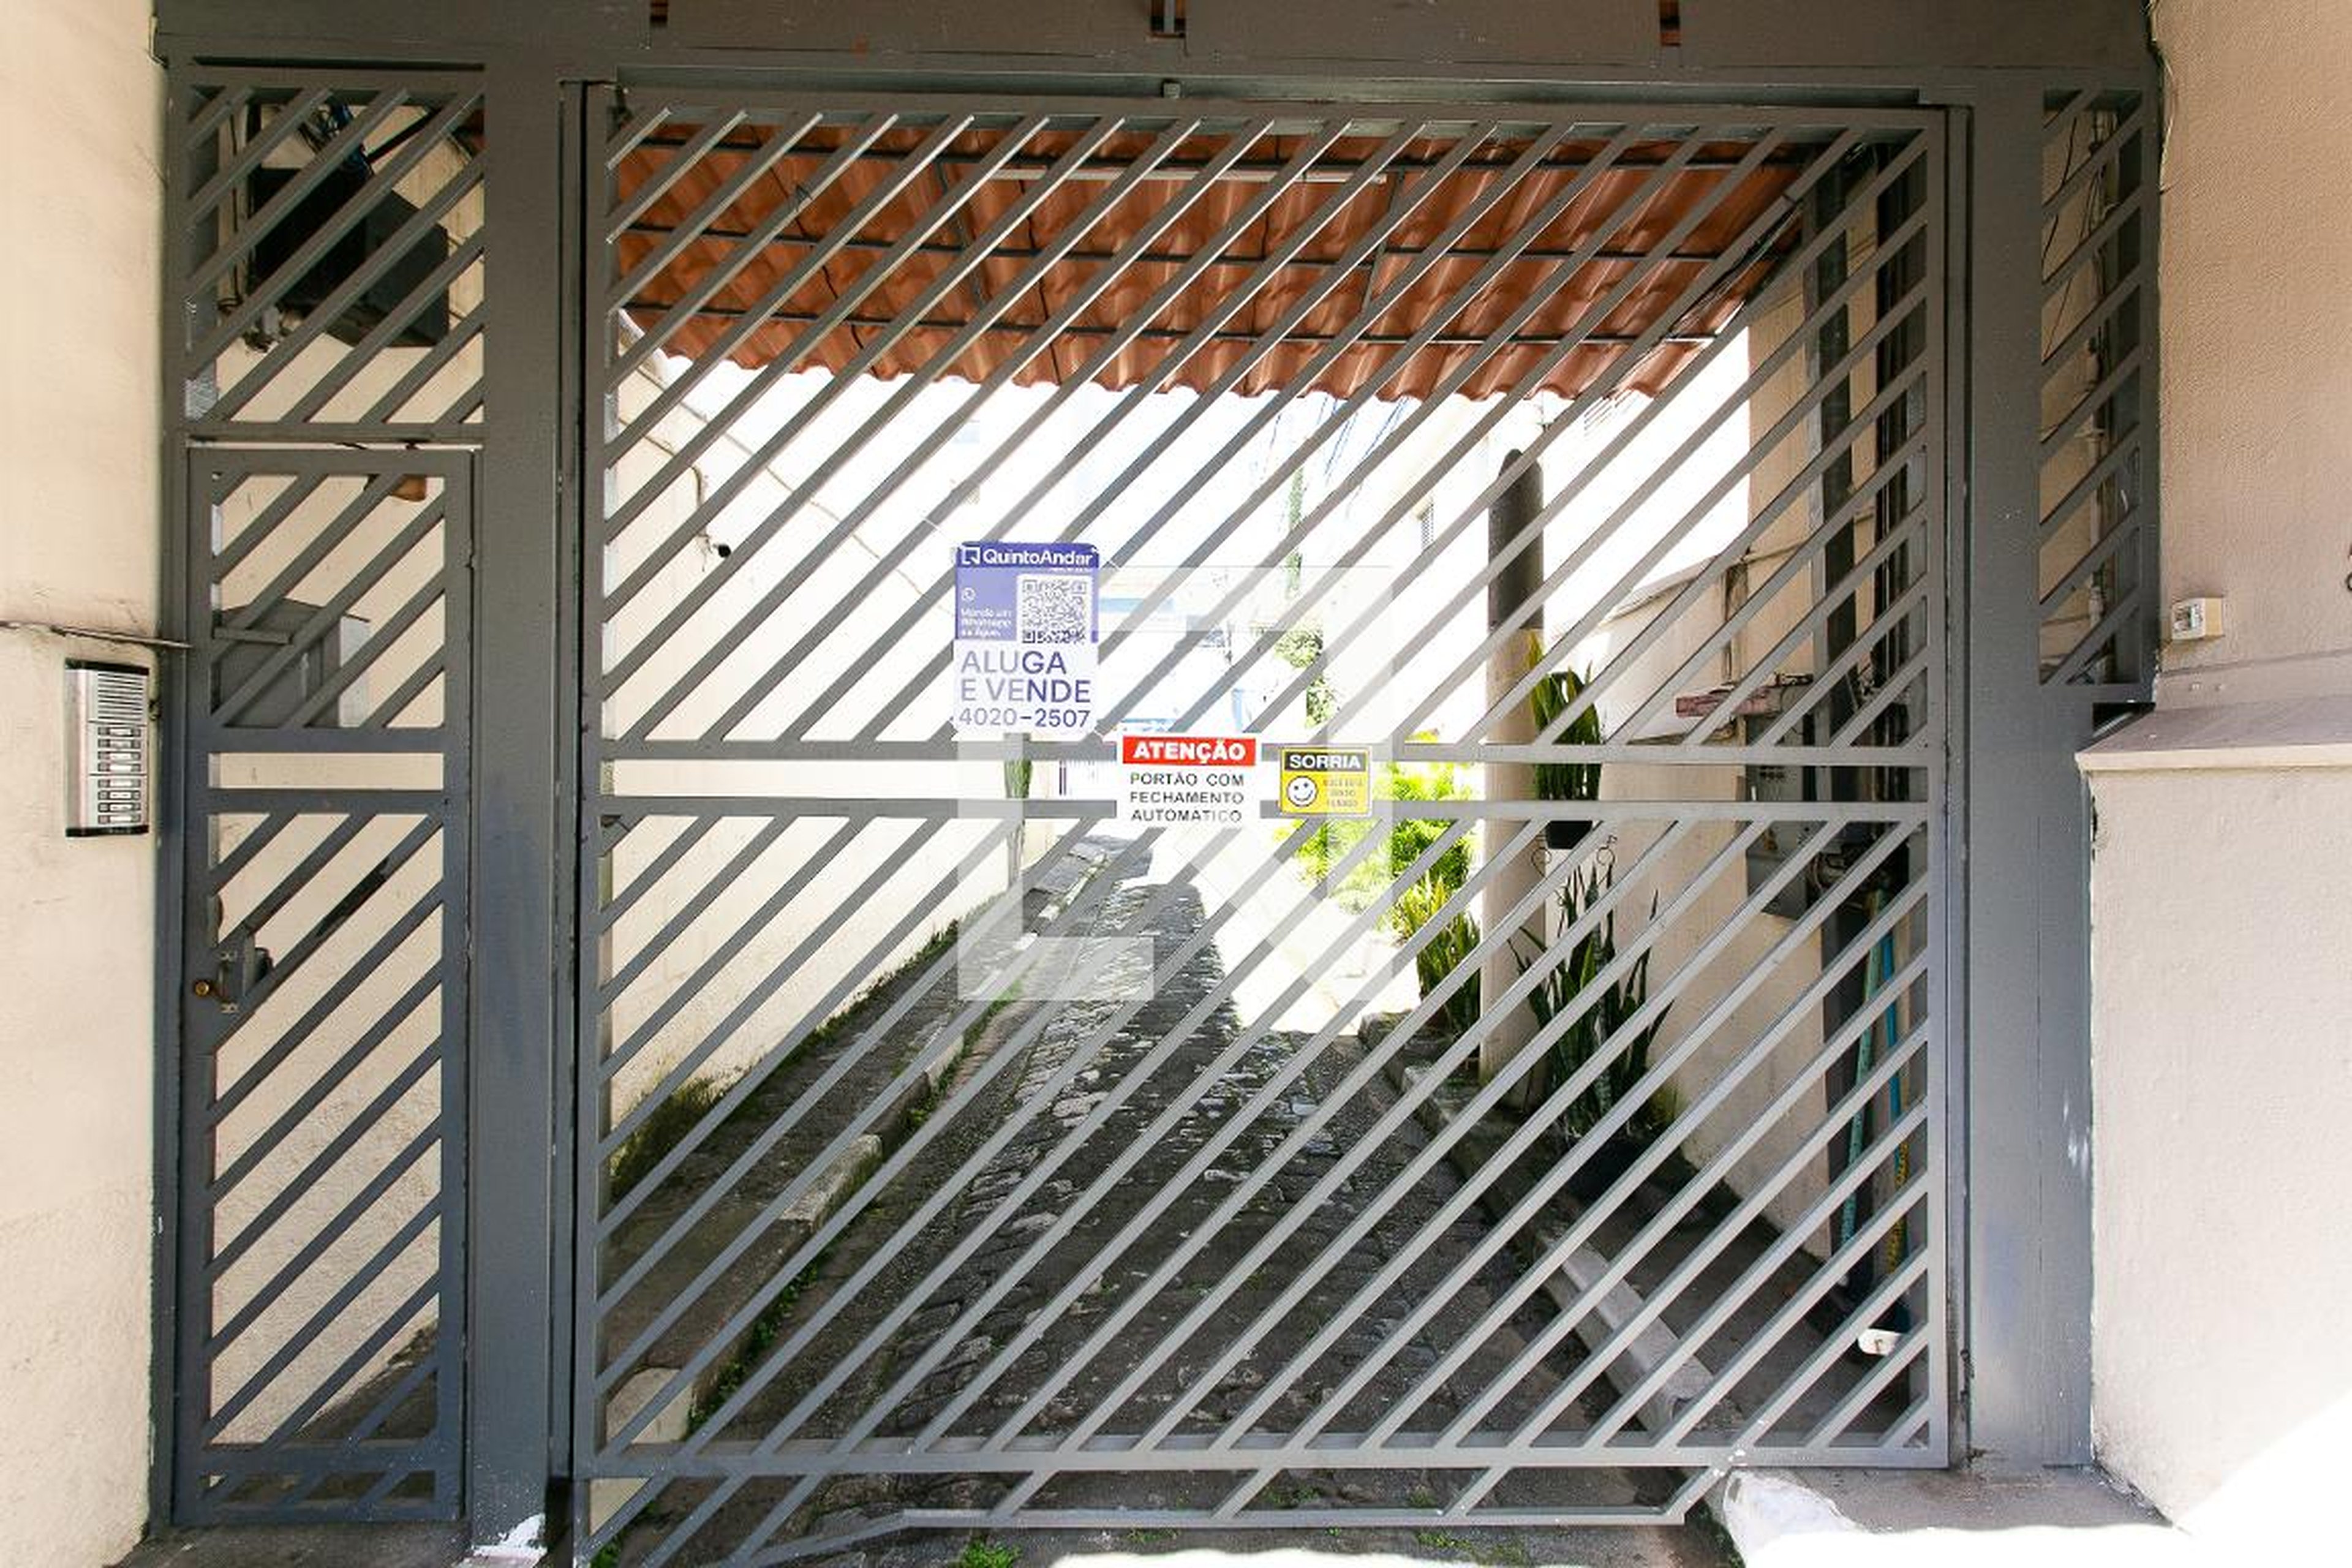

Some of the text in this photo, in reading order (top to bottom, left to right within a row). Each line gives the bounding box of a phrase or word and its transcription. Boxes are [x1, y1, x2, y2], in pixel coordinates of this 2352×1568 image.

[982, 548, 1093, 565] QuintoAndar
[960, 650, 1067, 674] ALUGA
[961, 679, 1091, 703] E VENDE
[959, 707, 1091, 728] 4020-2507
[1133, 739, 1246, 764] ATENÇÃO
[1289, 754, 1361, 769] SORRIA
[1129, 771, 1245, 787] PORTÃO COM
[1129, 791, 1245, 805] FECHAMENTO
